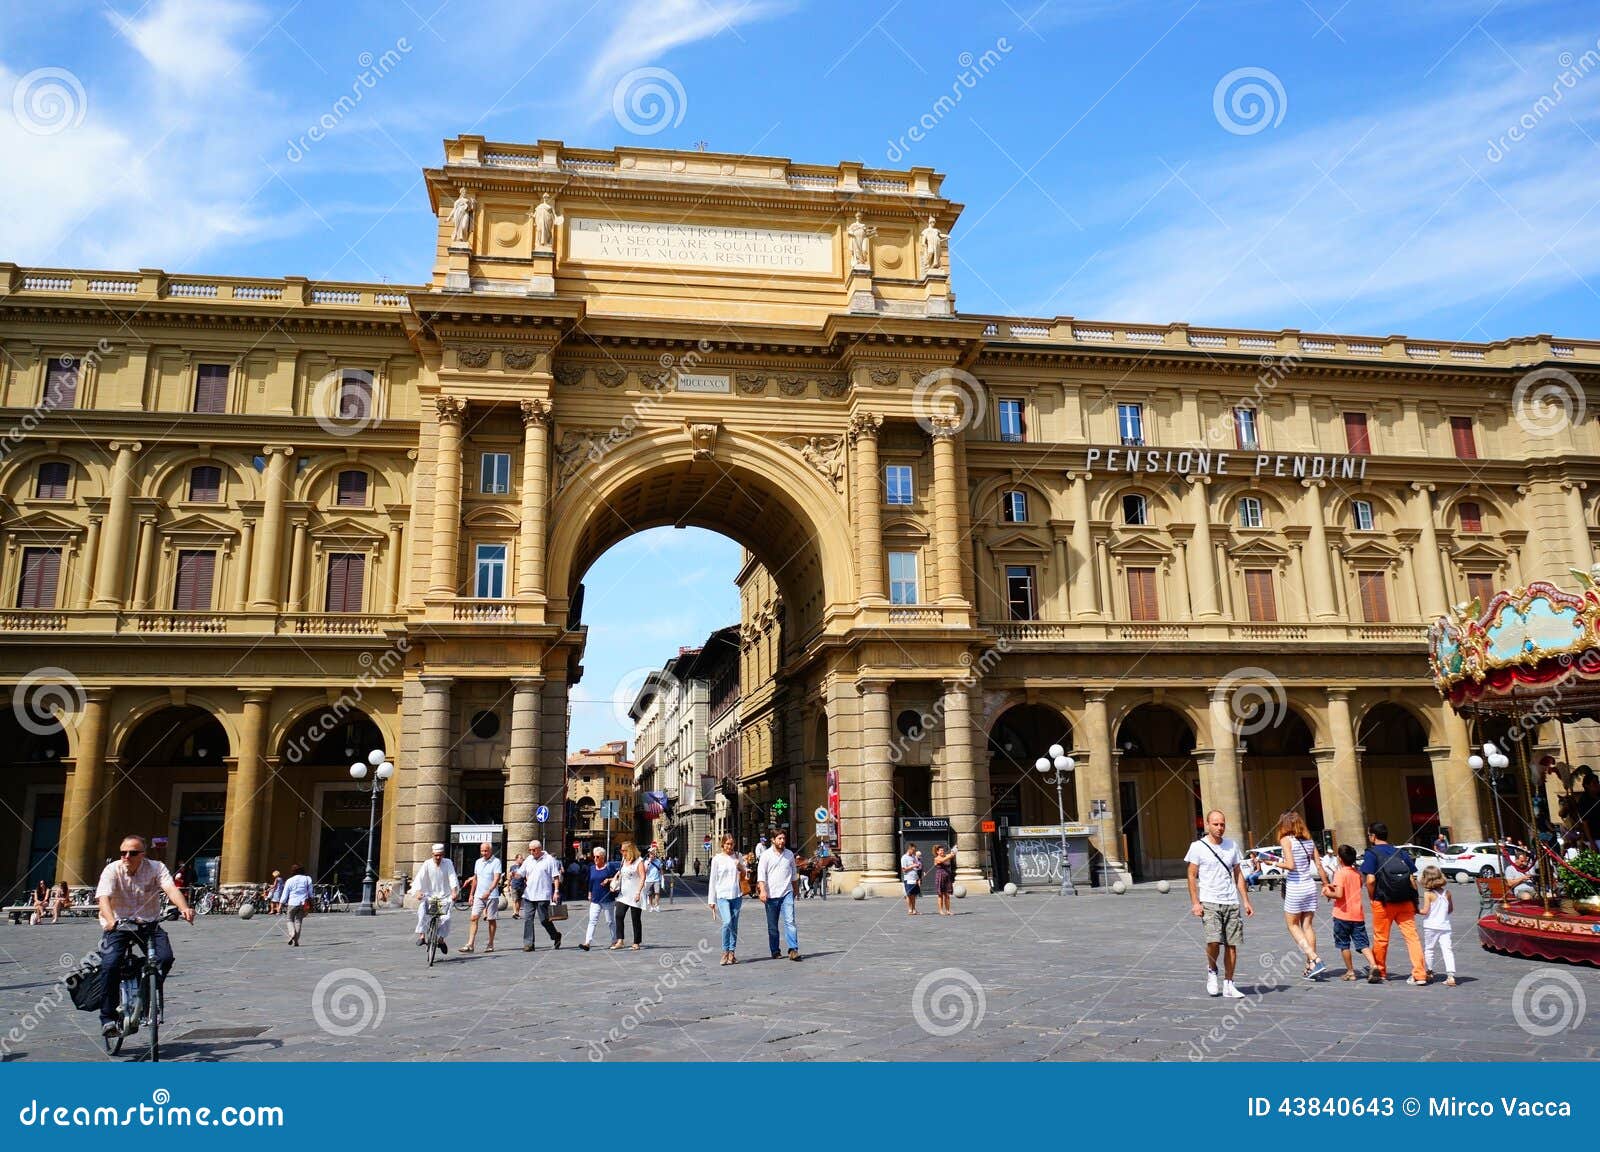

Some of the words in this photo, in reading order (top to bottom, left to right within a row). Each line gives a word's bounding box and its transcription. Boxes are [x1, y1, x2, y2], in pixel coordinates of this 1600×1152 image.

[600, 234, 620, 245] DA
[627, 236, 706, 250] SECOLARE
[714, 241, 803, 255] SQUALLORE
[600, 246, 609, 256] A
[616, 247, 650, 257] VITA
[658, 249, 709, 261] NUOVA
[716, 252, 804, 266] RESTITUITO
[1086, 448, 1230, 475] PENSIONE
[1255, 454, 1367, 480] PENDINI
[918, 820, 949, 828] FIORISTA
[460, 832, 491, 841] VOGUE
